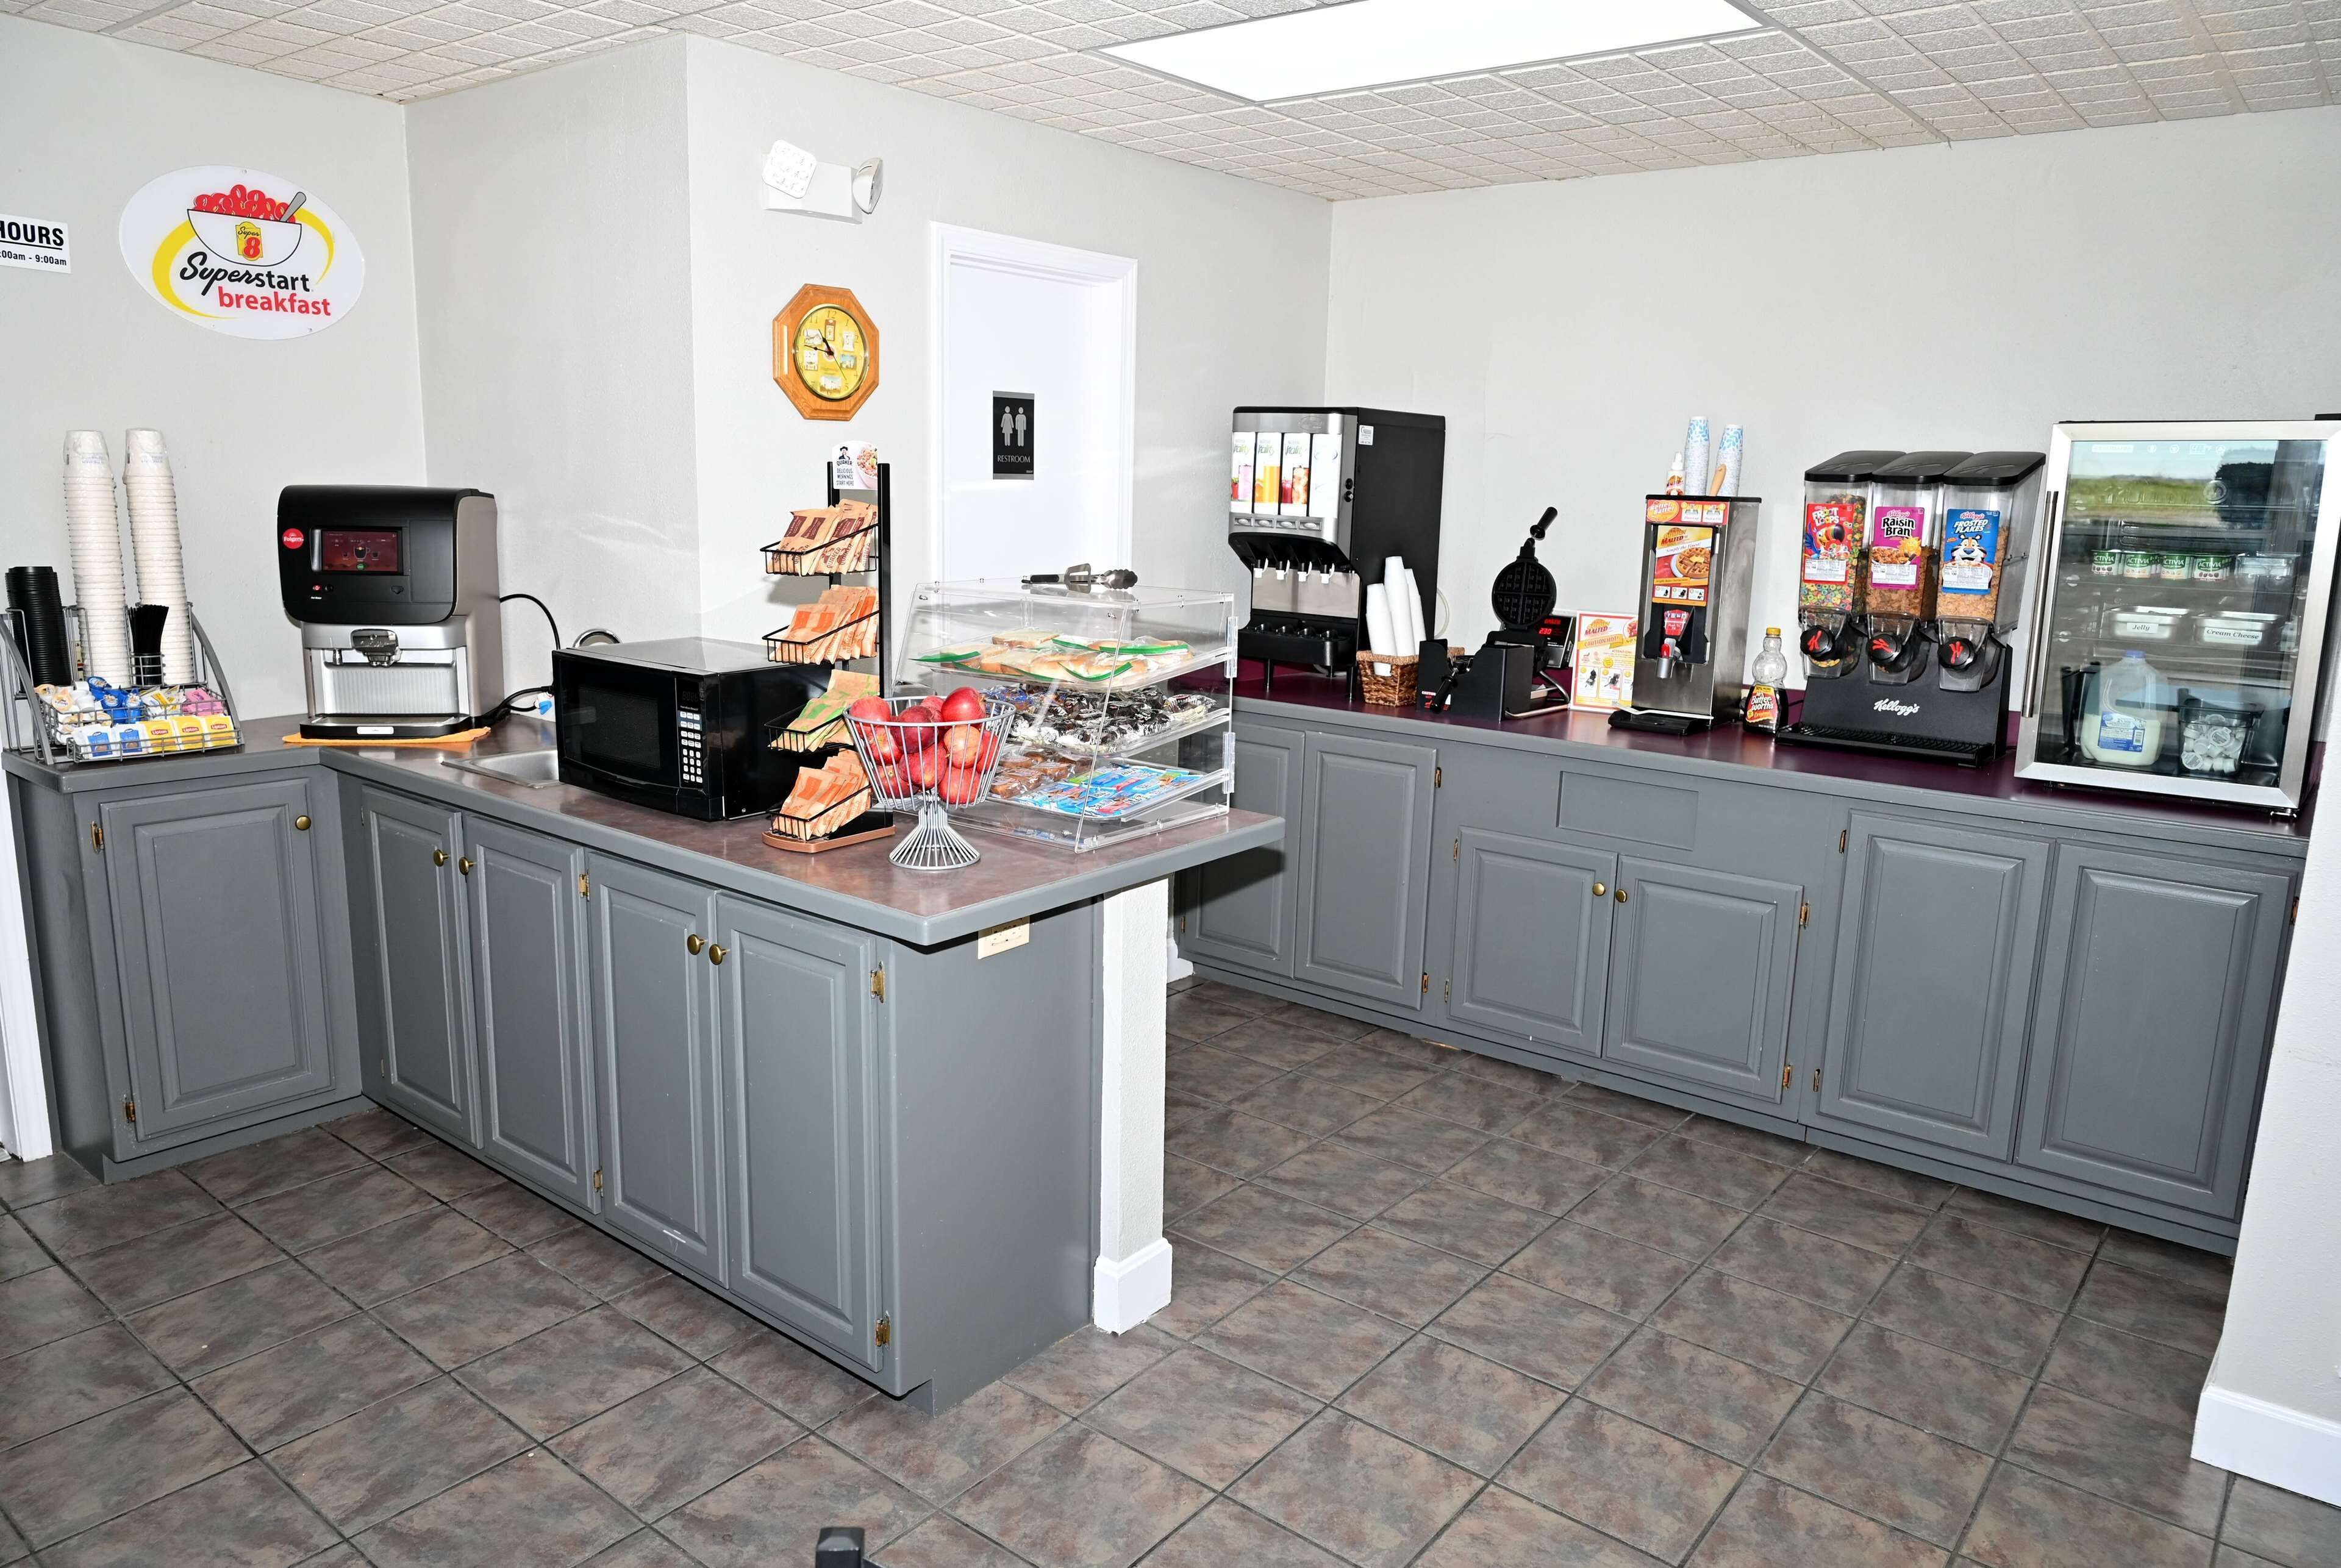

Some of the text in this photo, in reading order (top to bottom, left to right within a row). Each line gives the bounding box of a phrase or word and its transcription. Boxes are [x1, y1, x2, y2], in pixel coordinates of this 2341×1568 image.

[237, 226, 260, 239] Super
[243, 237, 260, 258] 8
[35, 254, 66, 266] 9:00am
[180, 251, 310, 296] Superstart
[218, 286, 331, 316] breakfast
[1812, 507, 1839, 521] FROOT
[1815, 515, 1840, 527] LOOPS
[1882, 517, 1915, 529] Raisin
[1954, 519, 1989, 528] FROSTED
[1885, 527, 1910, 536] Bran
[1955, 526, 1985, 534] FLAKES
[1660, 535, 1684, 545] MALTED
[826, 547, 843, 568] QUAKER
[1584, 626, 1608, 636] MALTED
[2206, 629, 2231, 637] Cream
[1584, 638, 1606, 647] CAUTION
[1751, 696, 1772, 705] Butter-
[1874, 698, 1920, 716] Kellogg's
